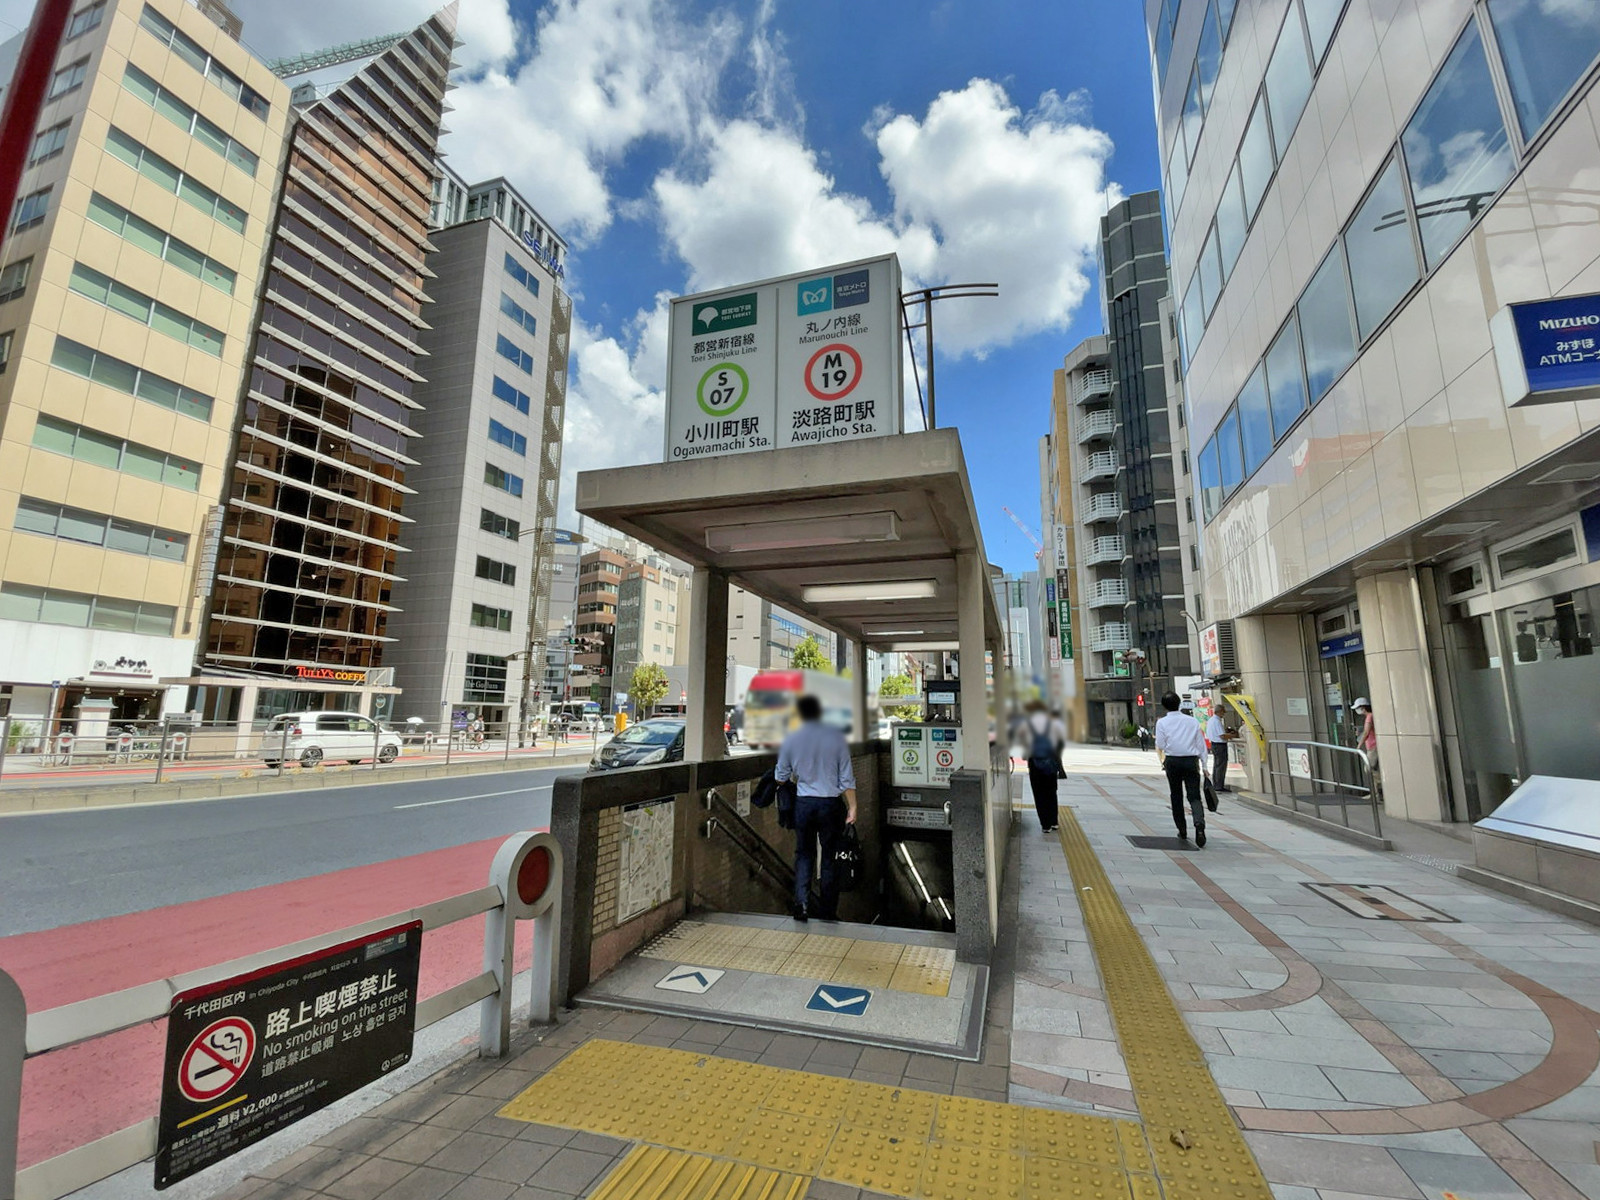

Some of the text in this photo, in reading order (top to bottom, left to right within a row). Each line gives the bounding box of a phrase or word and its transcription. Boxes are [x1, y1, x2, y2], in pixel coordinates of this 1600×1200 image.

[806, 313, 861, 334] 丸ノ内線
[1539, 315, 1600, 330] MIZUHO
[693, 333, 755, 354] 都営新宿線
[799, 326, 869, 344] Marunouchi Line
[1556, 338, 1595, 351] みずほ
[691, 346, 758, 363] Toei Shinjuku Line
[824, 352, 842, 369] M
[718, 371, 728, 387] S
[821, 369, 847, 389] 19
[709, 387, 735, 406] 07
[792, 400, 875, 429] 淡路町駅
[685, 416, 759, 443] 小川町駅
[791, 422, 877, 443] Awajicho Sta.
[673, 436, 771, 459] Ogawamachi Sta.
[296, 665, 334, 679] TULLY'S
[286, 976, 299, 988] City
[183, 989, 246, 1021] 千代田区内
[264, 966, 398, 1040] 路上喫煙禁止
[262, 987, 408, 1060] No smoking on the street
[341, 1022, 363, 1043] 노상
[387, 1002, 406, 1022] 금지
[261, 1033, 334, 1078] 道路禁止吸烟
[241, 1090, 278, 1118] ¥2,000
